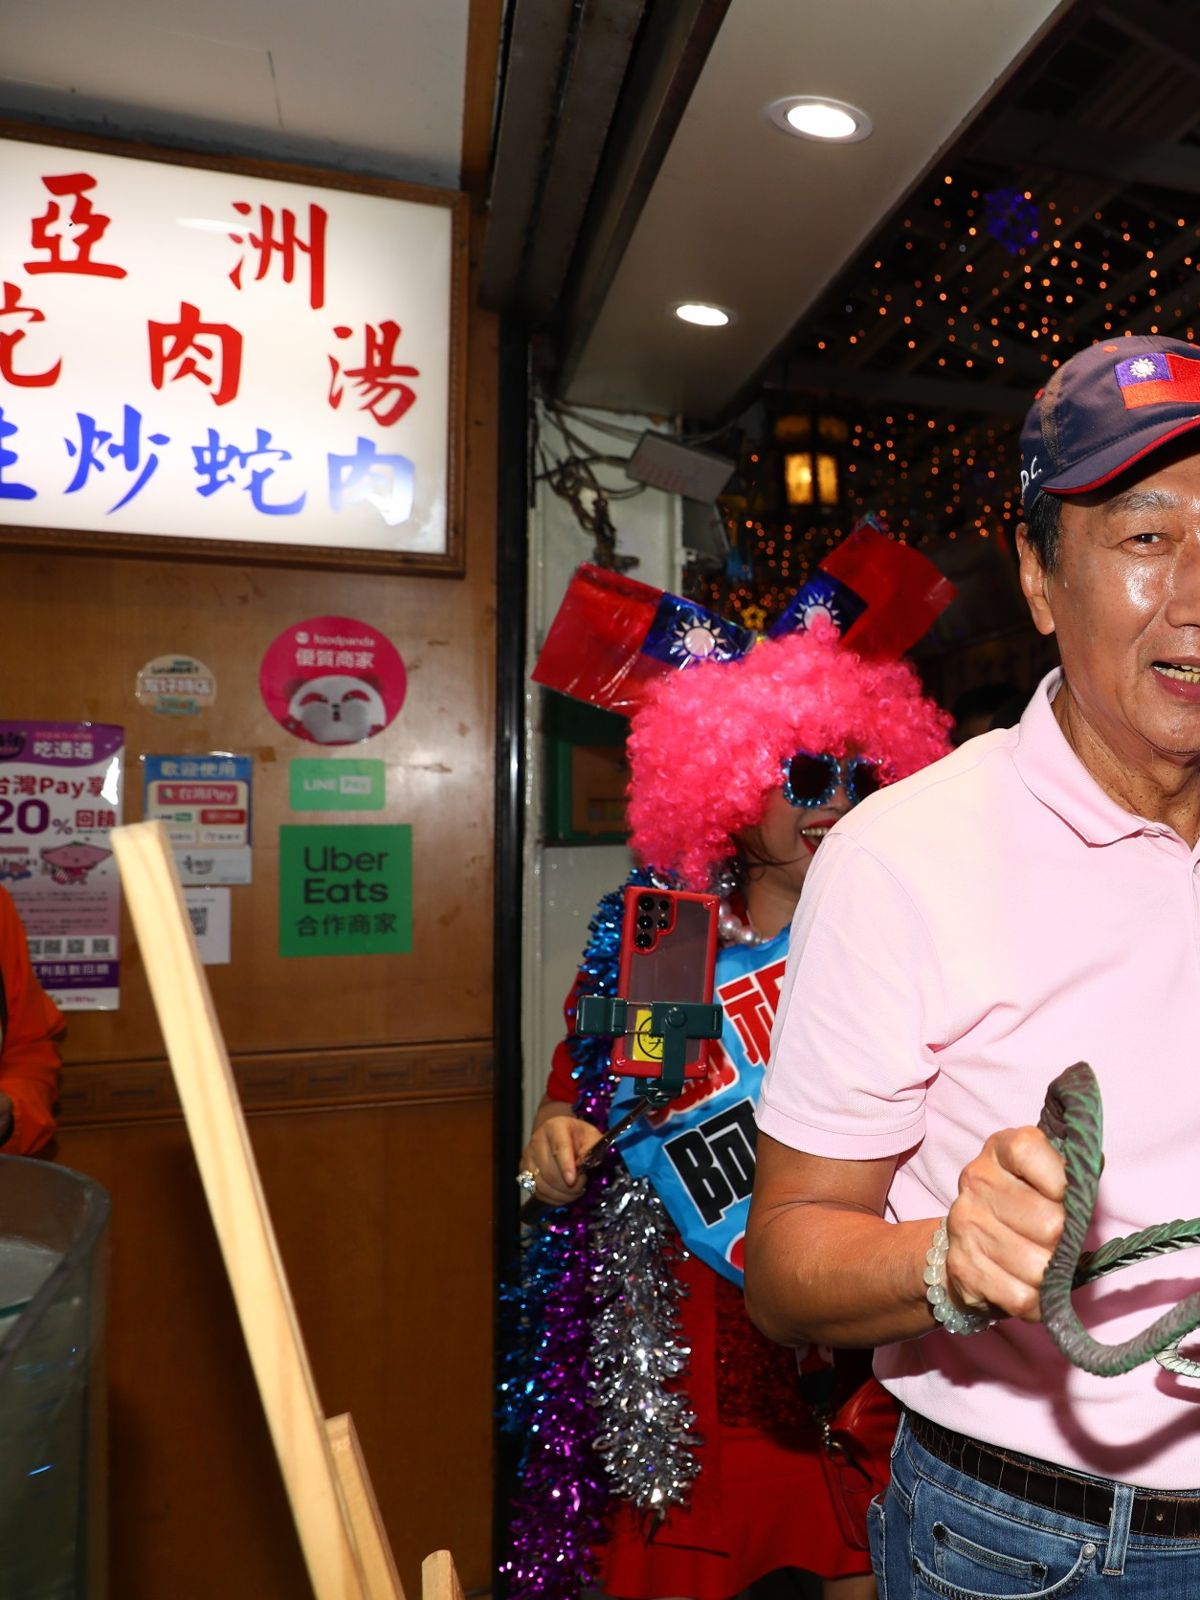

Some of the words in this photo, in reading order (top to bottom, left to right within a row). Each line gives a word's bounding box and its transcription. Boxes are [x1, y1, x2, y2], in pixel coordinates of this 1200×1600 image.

[23, 172, 328, 310] 亞洲
[313, 632, 376, 648] foodpanda
[295, 648, 375, 669] 優質商家
[303, 779, 336, 791] LINE
[303, 846, 388, 873] Uber
[303, 878, 389, 904] Eats
[296, 913, 397, 937] 合作商家
